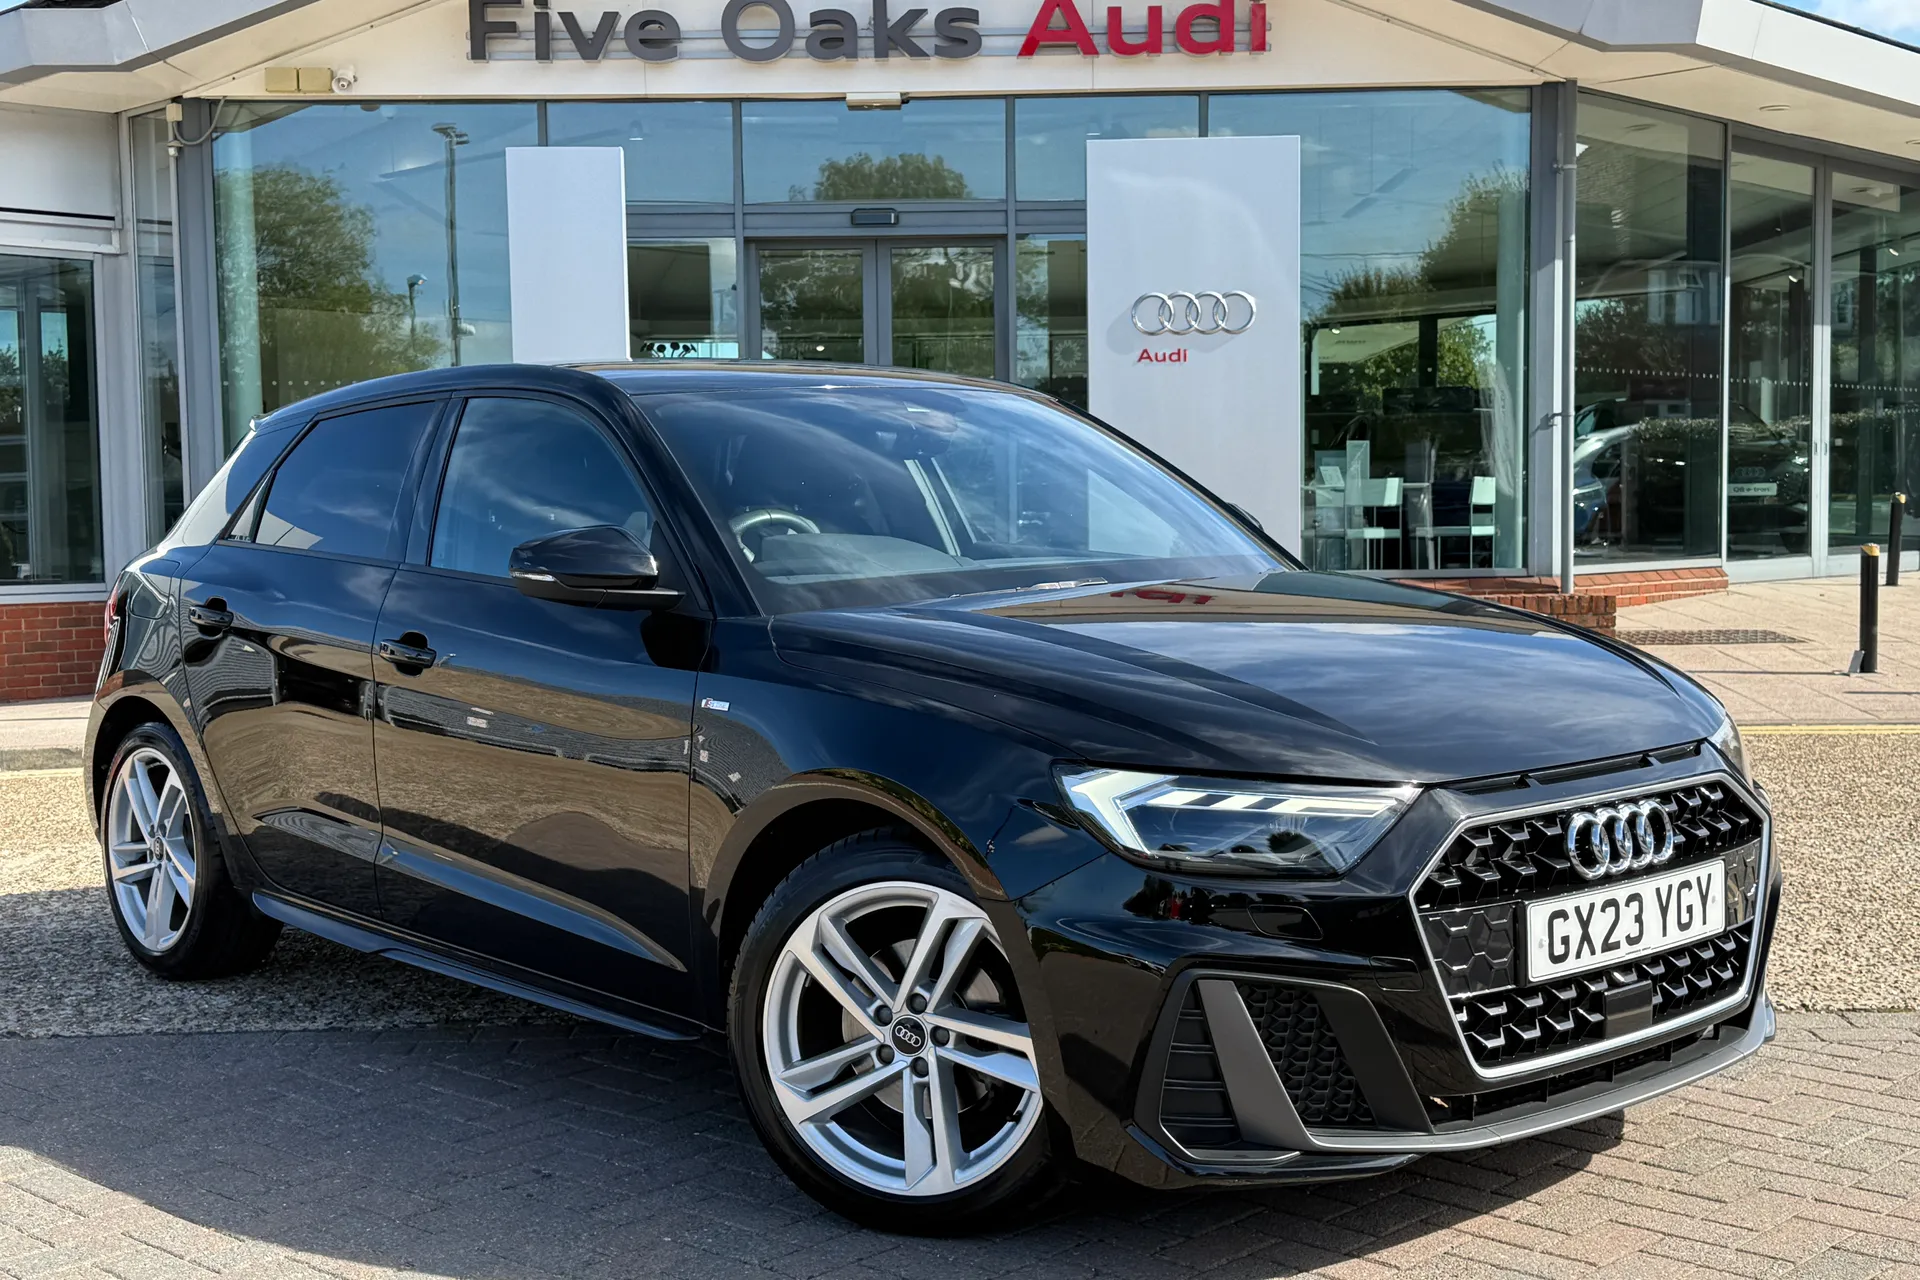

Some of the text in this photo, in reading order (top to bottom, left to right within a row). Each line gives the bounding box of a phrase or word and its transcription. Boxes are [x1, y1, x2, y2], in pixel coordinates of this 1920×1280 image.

[469, 0, 1267, 64] Five Oaks Audi
[1137, 348, 1188, 363] Audi
[1547, 873, 1712, 965] GX23 YGY
